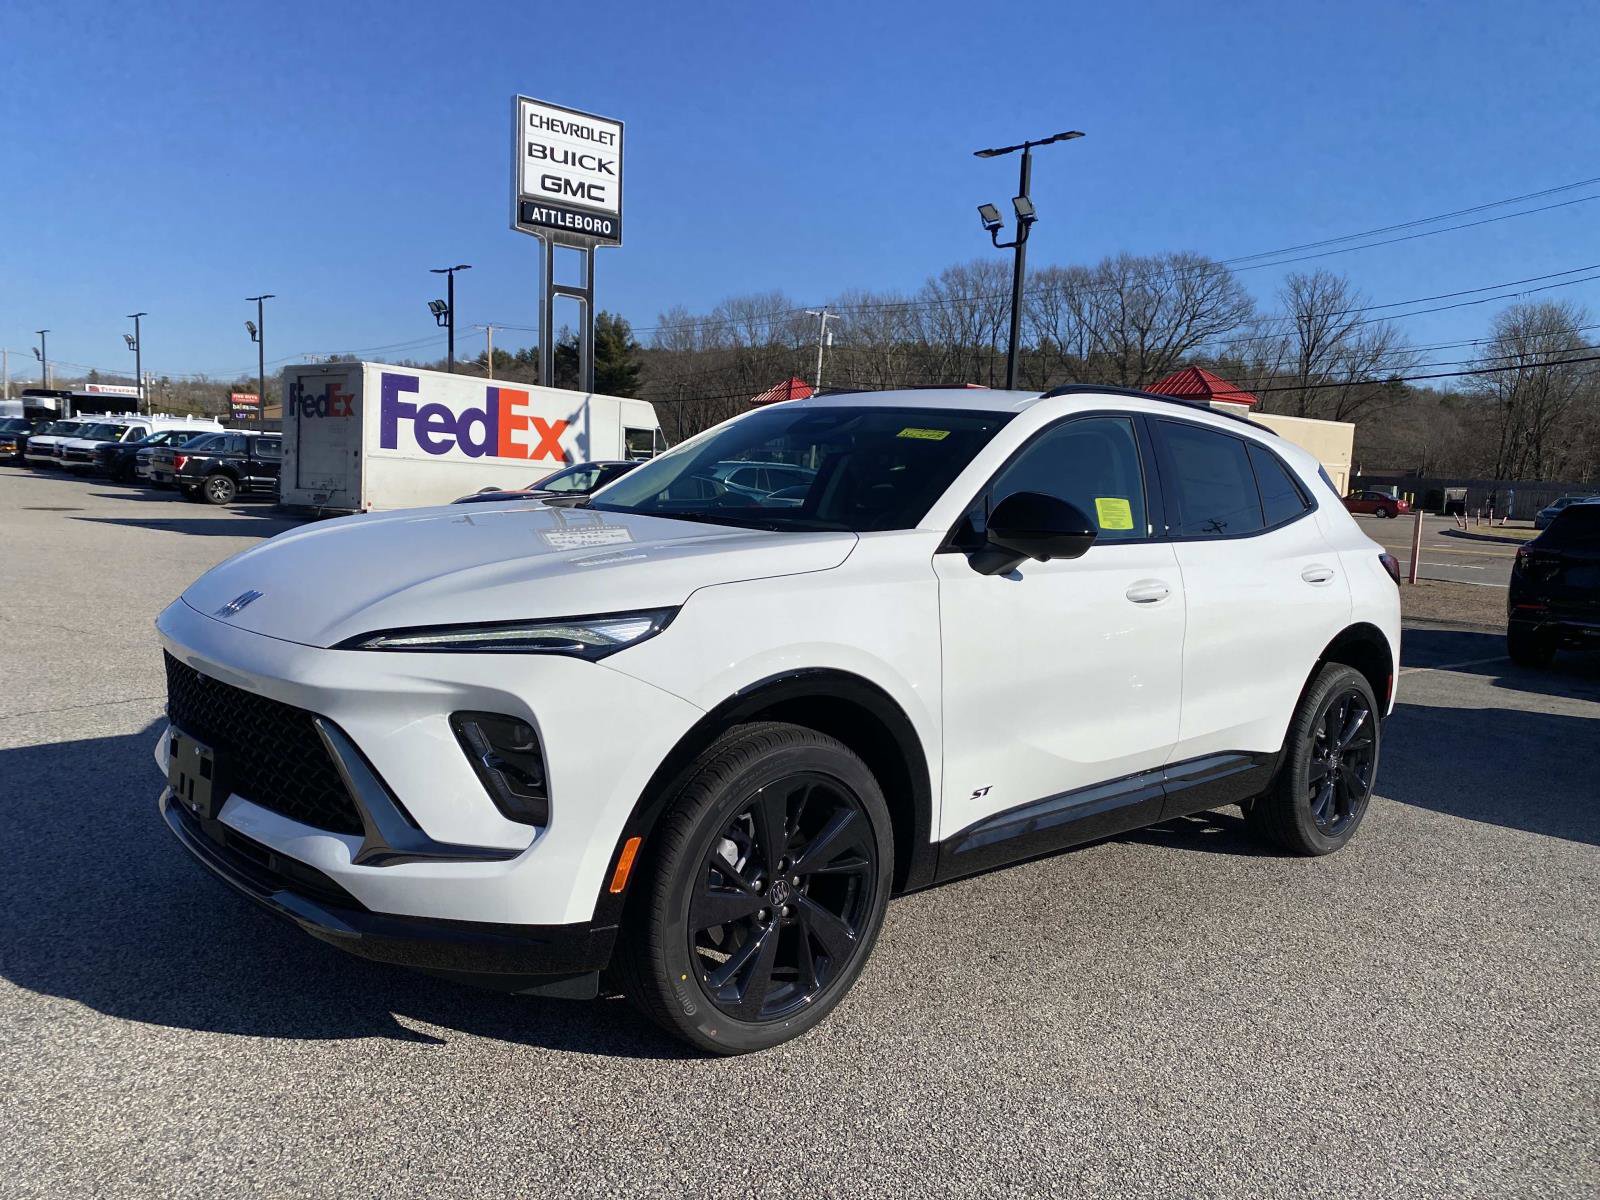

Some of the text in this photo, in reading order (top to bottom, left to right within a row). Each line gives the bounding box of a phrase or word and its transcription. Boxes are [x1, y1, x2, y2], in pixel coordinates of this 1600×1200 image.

[530, 113, 616, 146] CHEVROLET
[528, 142, 616, 176] BUICK
[541, 174, 605, 202] GMC
[532, 207, 611, 234] ATTLEBORO
[289, 383, 355, 418] FedEx
[380, 372, 570, 462] FedEx
[970, 785, 993, 800] ST
